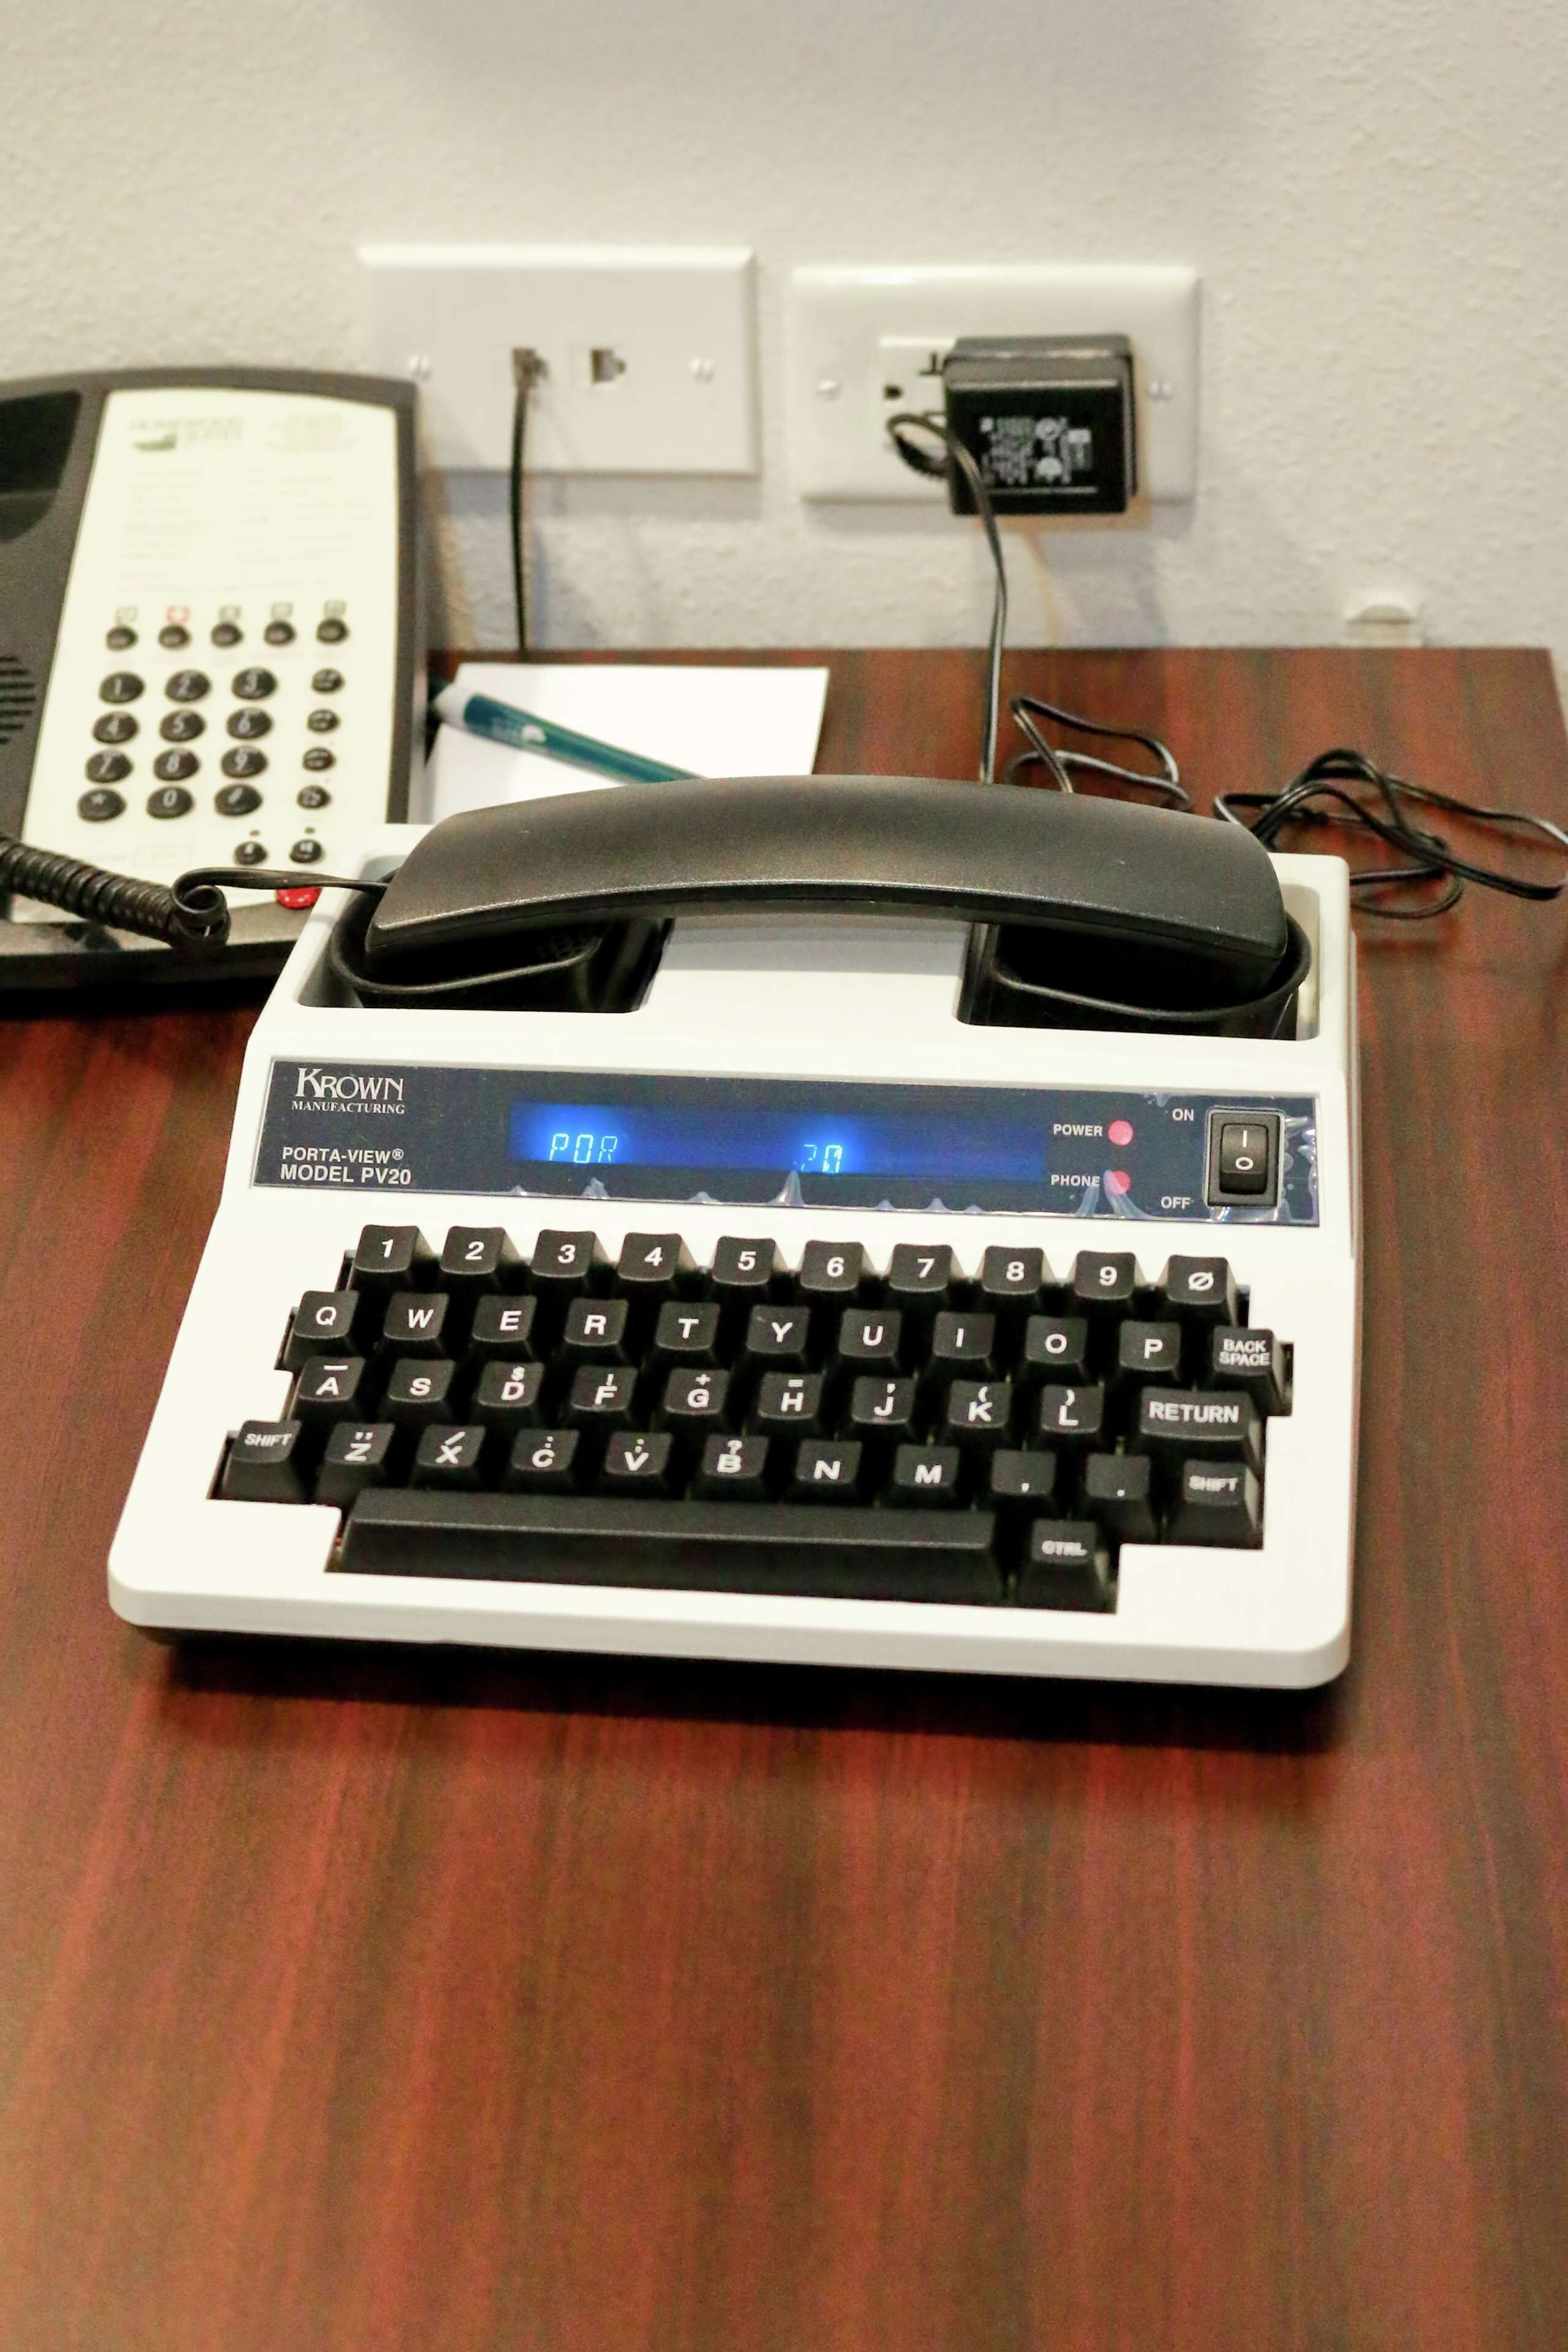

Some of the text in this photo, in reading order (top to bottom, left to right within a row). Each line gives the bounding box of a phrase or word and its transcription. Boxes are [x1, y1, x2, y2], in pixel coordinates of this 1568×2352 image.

[292, 1100, 405, 1114] MANUFACTURING
[1172, 1108, 1194, 1121] ON
[1053, 1124, 1103, 1136] POWER
[281, 1164, 411, 1184] MODEL PV20
[1050, 1174, 1100, 1187] PHONE
[1161, 1196, 1191, 1209] OFF
[382, 1239, 393, 1257] 1
[465, 1241, 484, 1260] 2
[558, 1244, 575, 1263] 3
[645, 1247, 662, 1266] 4
[738, 1252, 756, 1270] 5
[827, 1257, 844, 1277] 6
[918, 1258, 934, 1277] 7
[1006, 1261, 1024, 1281] 8
[1099, 1266, 1117, 1285] 9
[316, 1307, 1163, 1358] Q W E R T Y U I O P
[1223, 1339, 1266, 1353] BACK
[1219, 1351, 1270, 1366] SPACE
[316, 1377, 1238, 1426] A S D F G H J K L RETURN
[245, 1434, 292, 1446] SHIFT
[345, 1443, 371, 1461] Z
[436, 1445, 462, 1464] X
[533, 1450, 554, 1467] C
[624, 1452, 649, 1470] V
[717, 1454, 742, 1473] B
[815, 1461, 840, 1479] N
[915, 1465, 941, 1483] M
[1189, 1476, 1237, 1491] SHIFT
